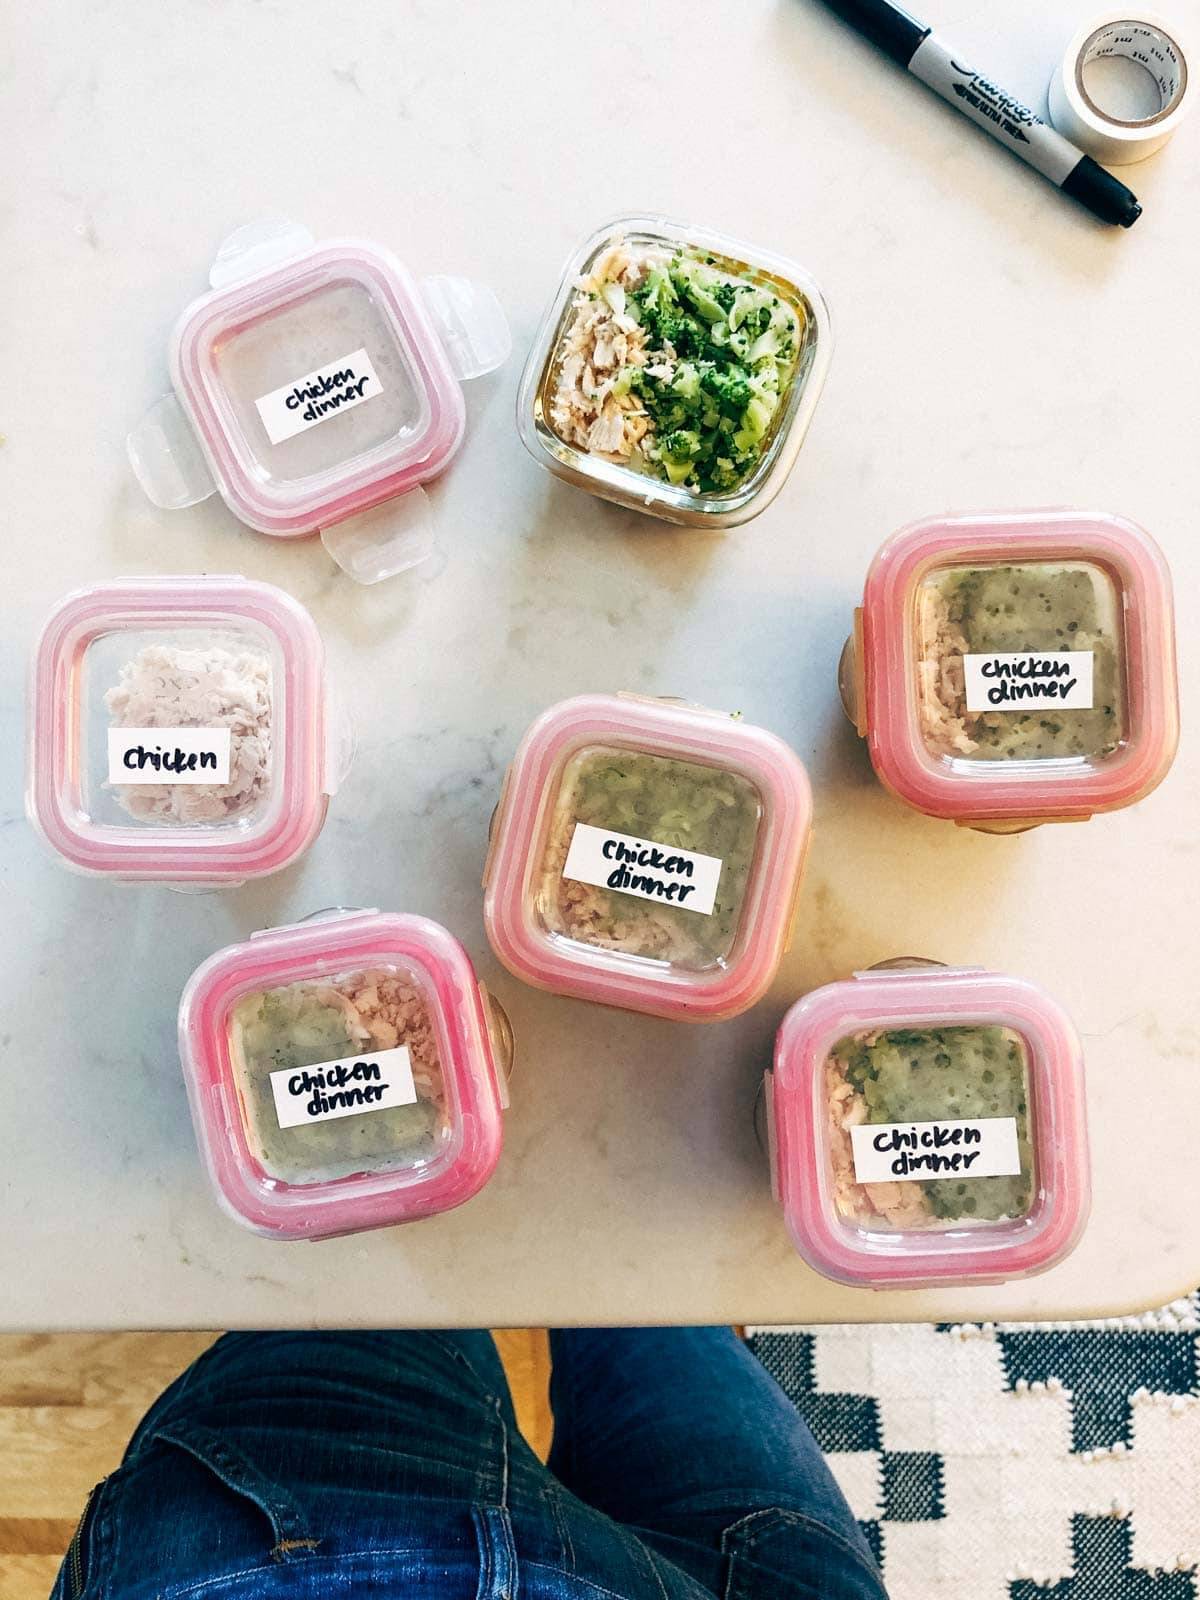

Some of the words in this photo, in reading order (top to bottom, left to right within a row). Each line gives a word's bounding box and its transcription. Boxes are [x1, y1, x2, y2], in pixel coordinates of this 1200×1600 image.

[303, 376, 369, 421] dinner
[988, 678, 1077, 704] dinner
[607, 863, 695, 902] dinner
[307, 1083, 389, 1116] dinner
[891, 1151, 980, 1175] dinner
